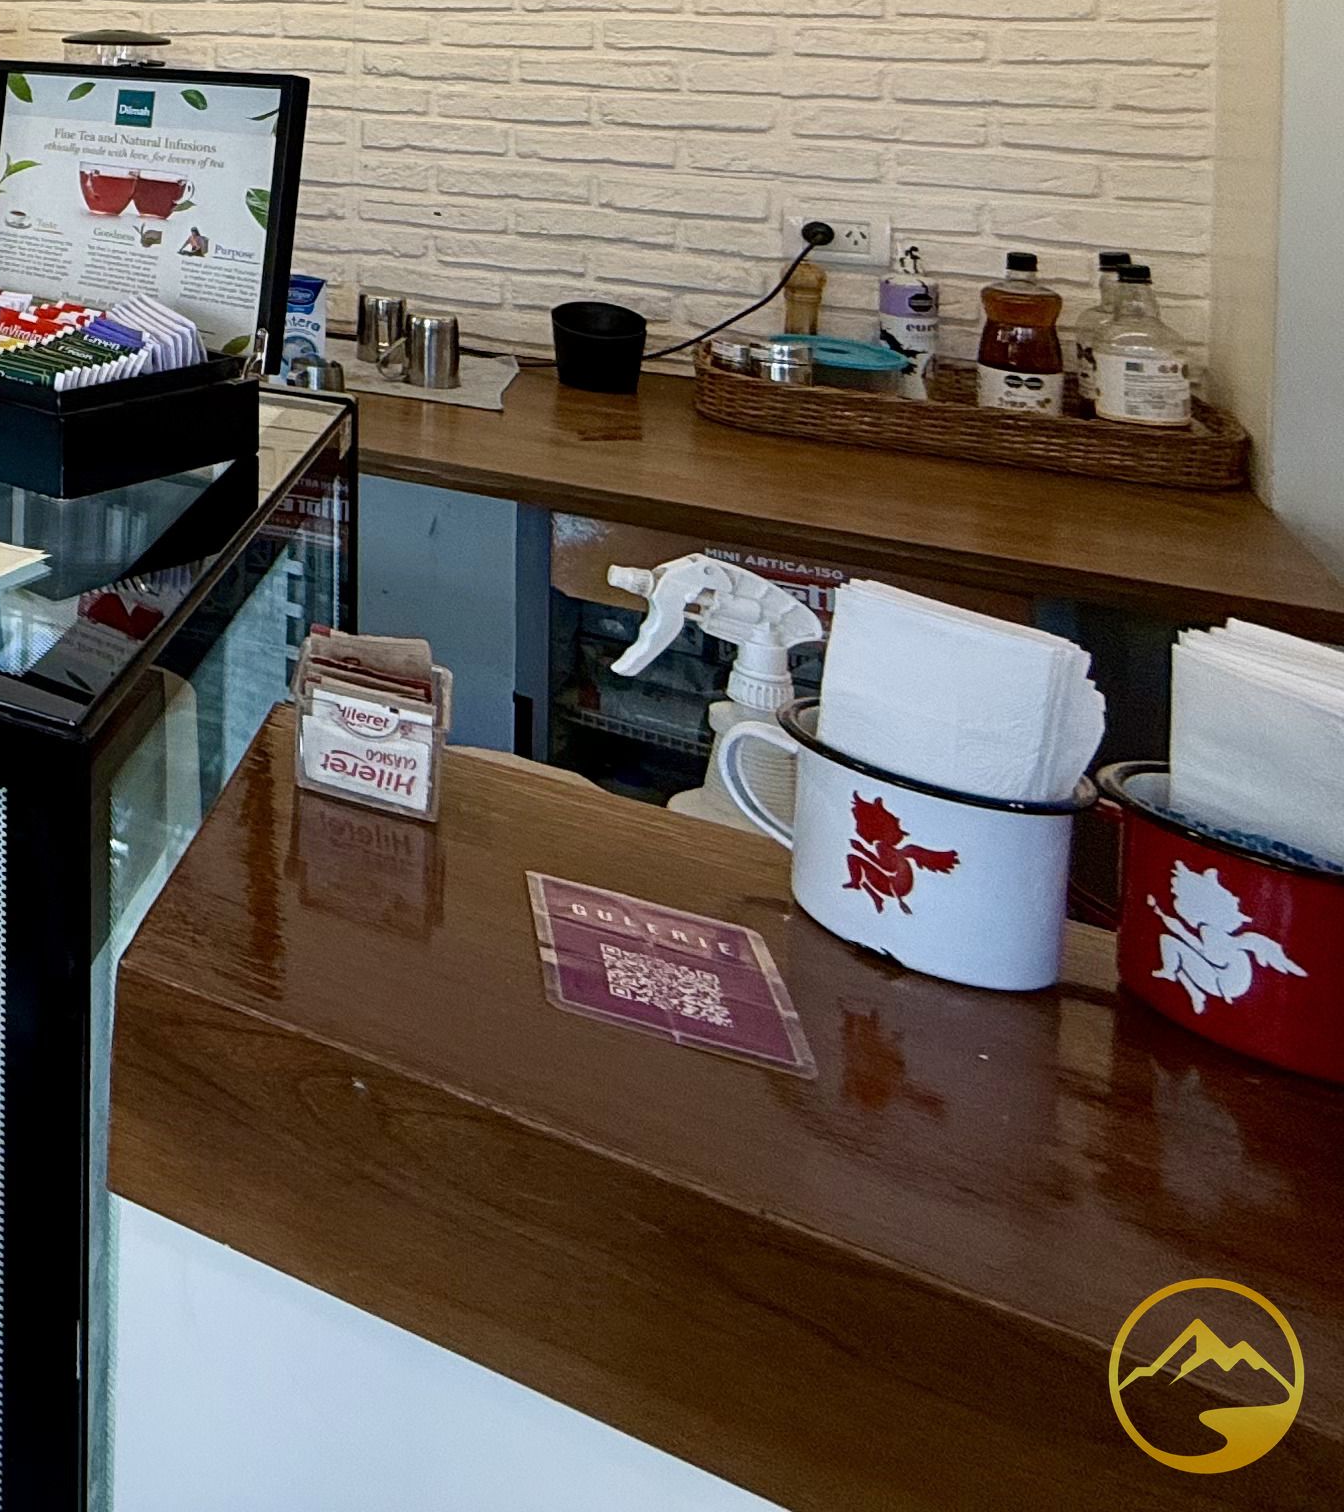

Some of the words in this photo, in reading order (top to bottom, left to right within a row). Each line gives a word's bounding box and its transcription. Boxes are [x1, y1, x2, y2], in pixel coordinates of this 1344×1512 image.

[118, 104, 151, 118] Dilmah
[54, 127, 76, 140] Fine
[79, 130, 95, 142] Tea
[96, 132, 118, 144] and
[121, 134, 162, 149] Natural
[164, 137, 217, 154] Infusions
[107, 147, 128, 159] with
[149, 151, 167, 164] for
[197, 156, 209, 169] of
[210, 158, 225, 169] tea
[93, 227, 135, 241] Goodness
[215, 244, 255, 259] Purpose
[704, 547, 741, 563] MINI
[744, 554, 846, 580] ARTICA-150
[320, 753, 417, 796] Hileret
[570, 902, 735, 957] GULERIE
